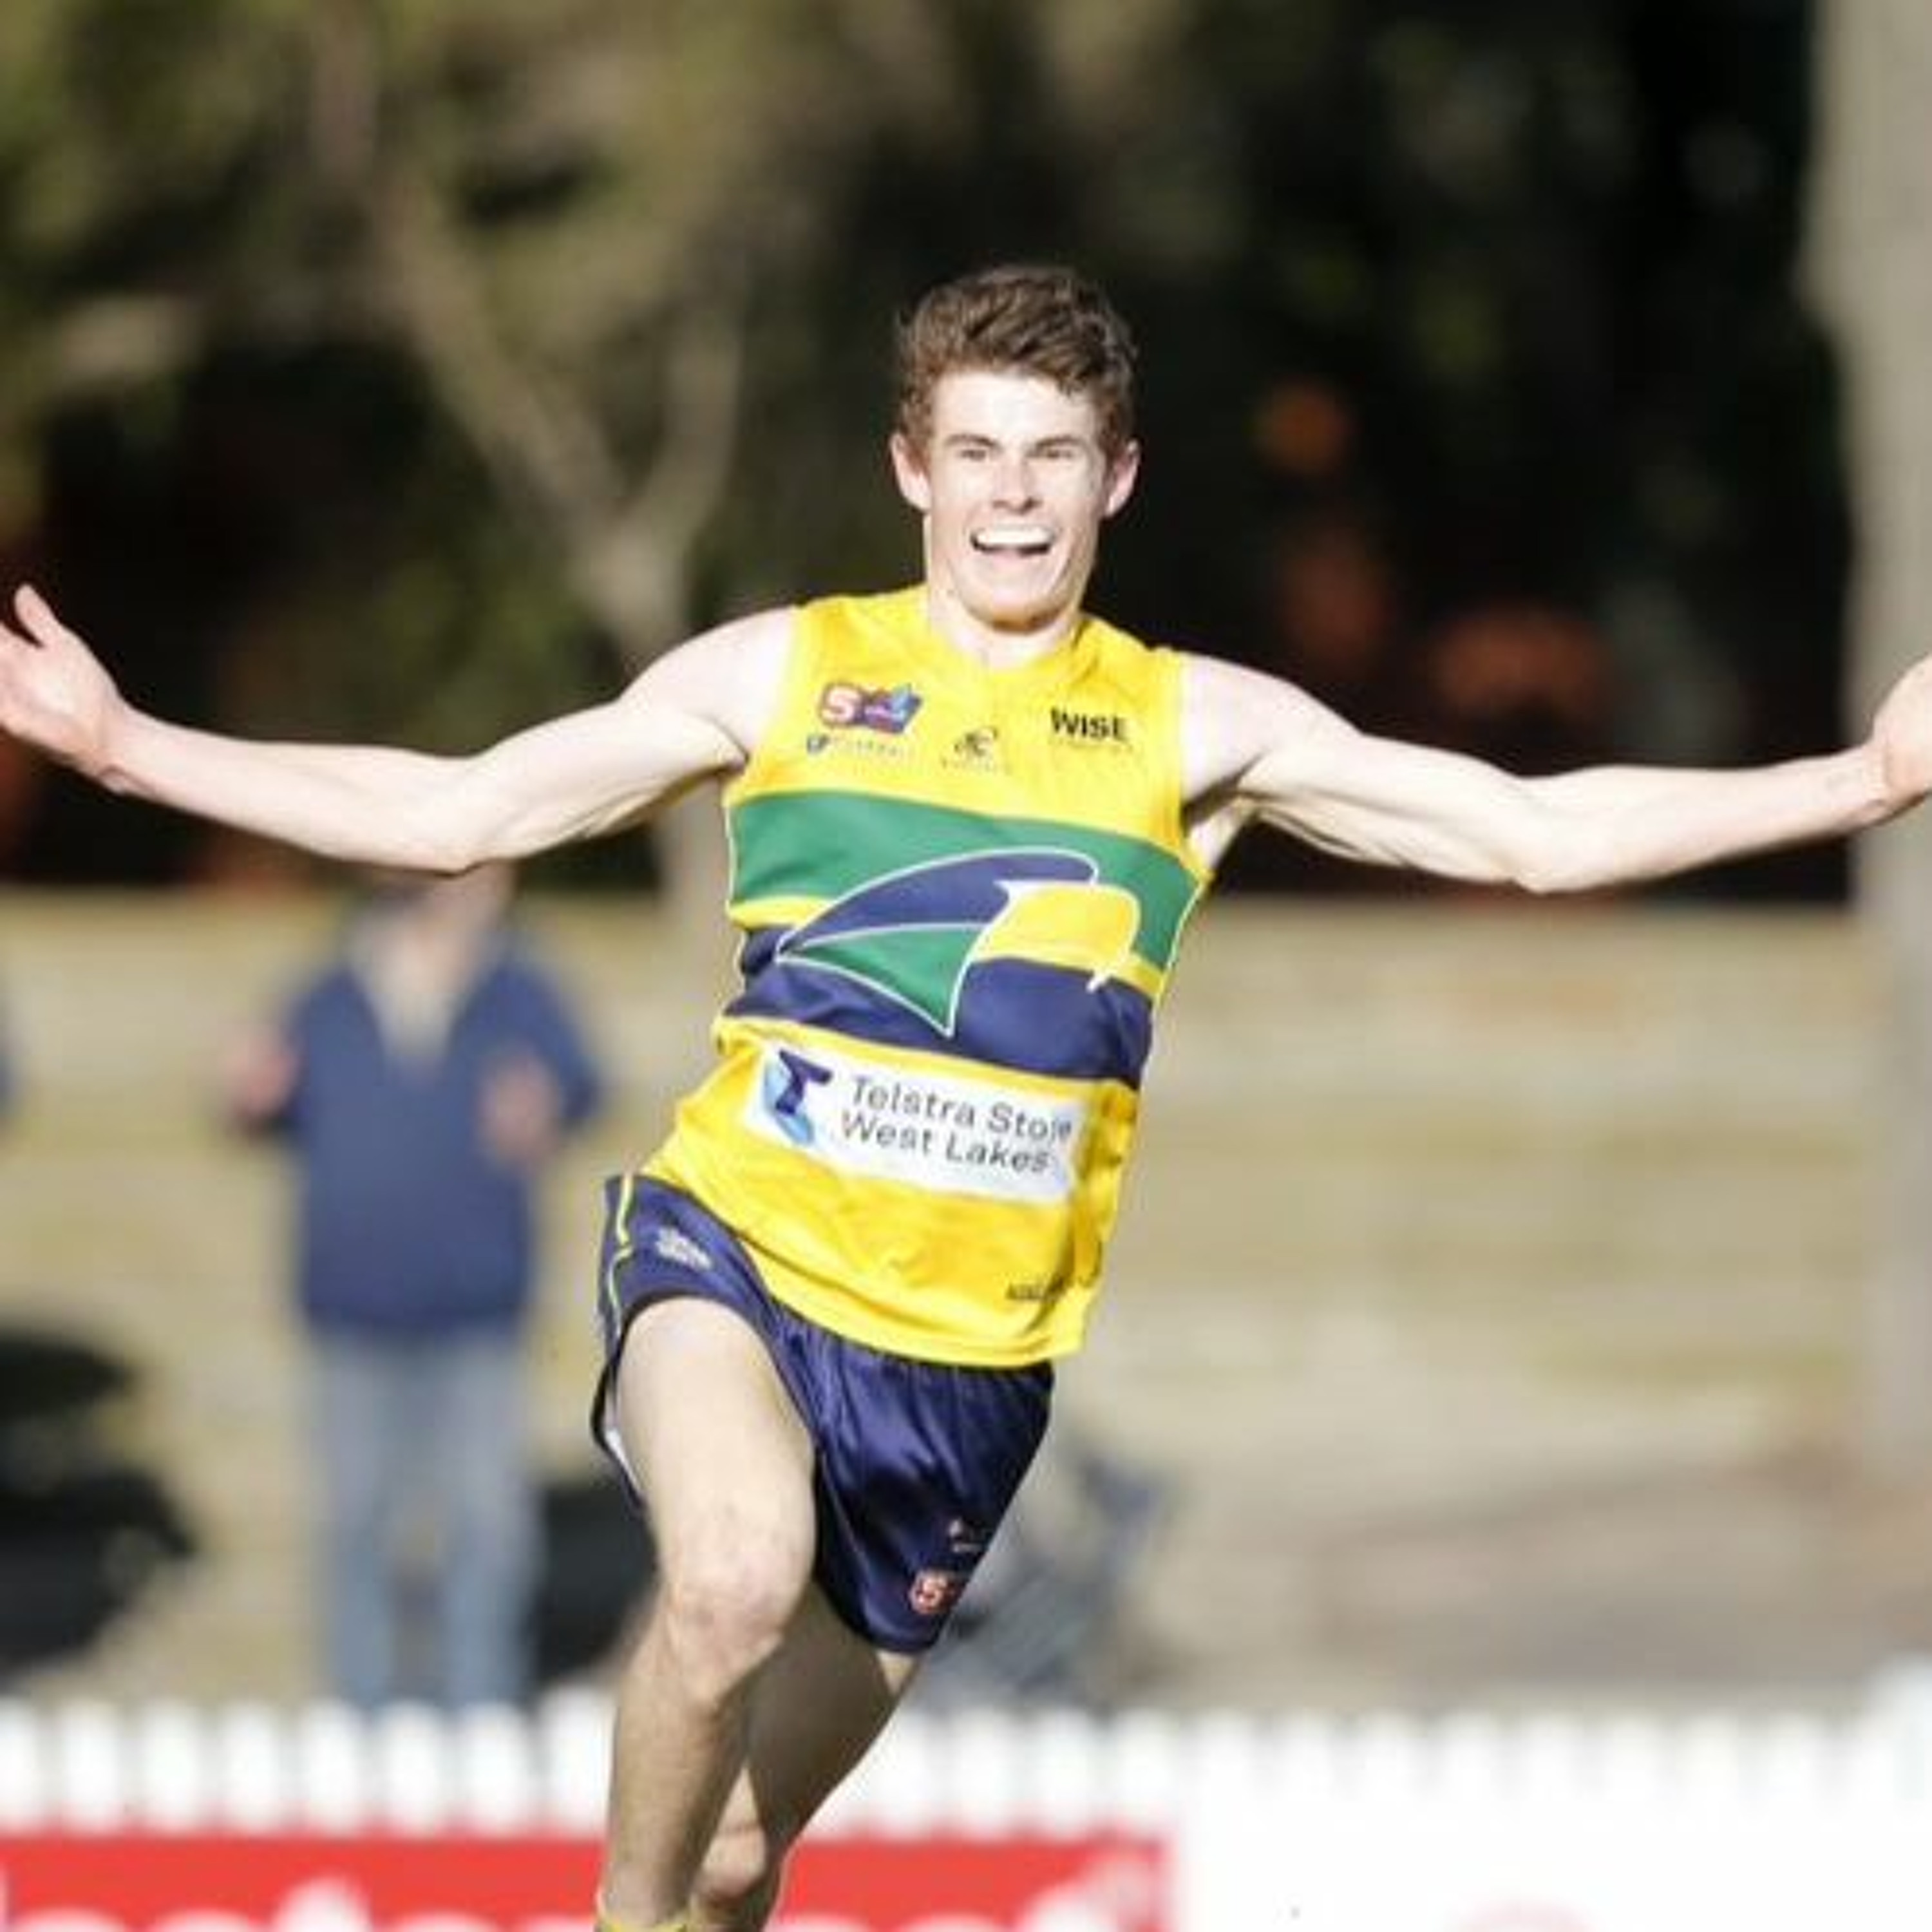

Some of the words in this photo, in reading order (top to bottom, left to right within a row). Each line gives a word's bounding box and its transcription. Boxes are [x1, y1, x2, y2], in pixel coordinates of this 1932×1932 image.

[1050, 706, 1128, 742] WISE
[852, 1075, 975, 1128] Telstra
[842, 1109, 933, 1157] West
[945, 1130, 1051, 1173] Lakes
